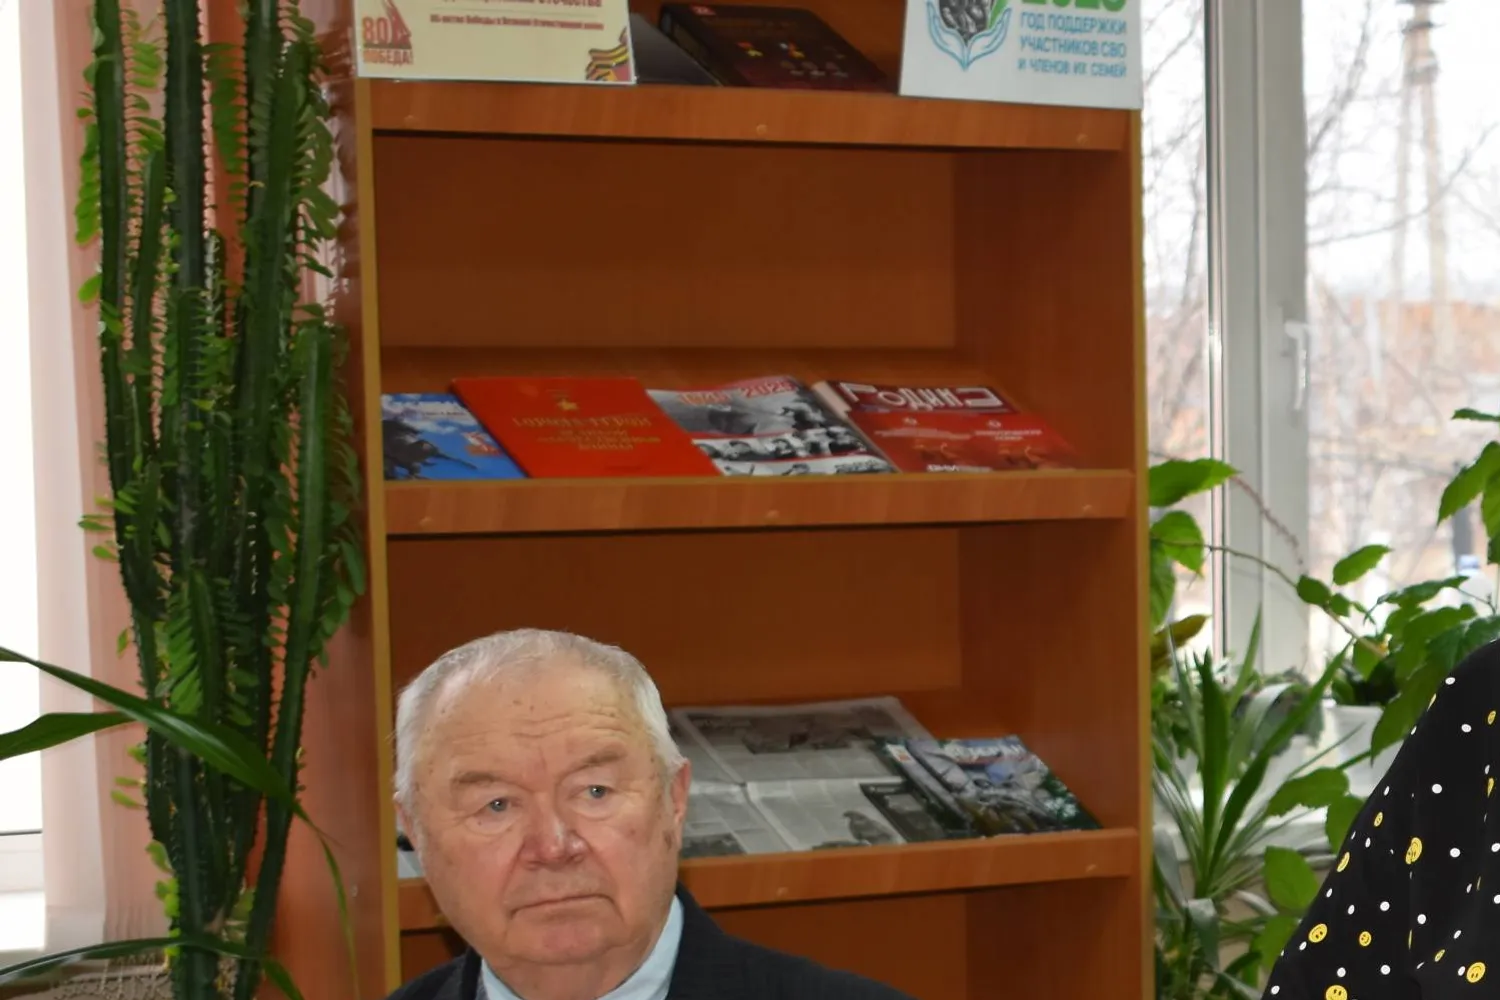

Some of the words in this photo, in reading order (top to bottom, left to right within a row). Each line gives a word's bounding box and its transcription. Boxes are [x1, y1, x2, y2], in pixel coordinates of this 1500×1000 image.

[1020, 12, 1046, 31] ГОД
[1048, 15, 1127, 35] ПОДДЕРЖКИ
[1019, 36, 1099, 57] УЧАСТНИКОВ
[1100, 41, 1127, 58] СВО
[1018, 58, 1026, 71] И
[1030, 60, 1070, 75] ЧЛЕНОВ
[1073, 62, 1087, 76] ИХ
[1090, 62, 1127, 78] СЕМЕЙ
